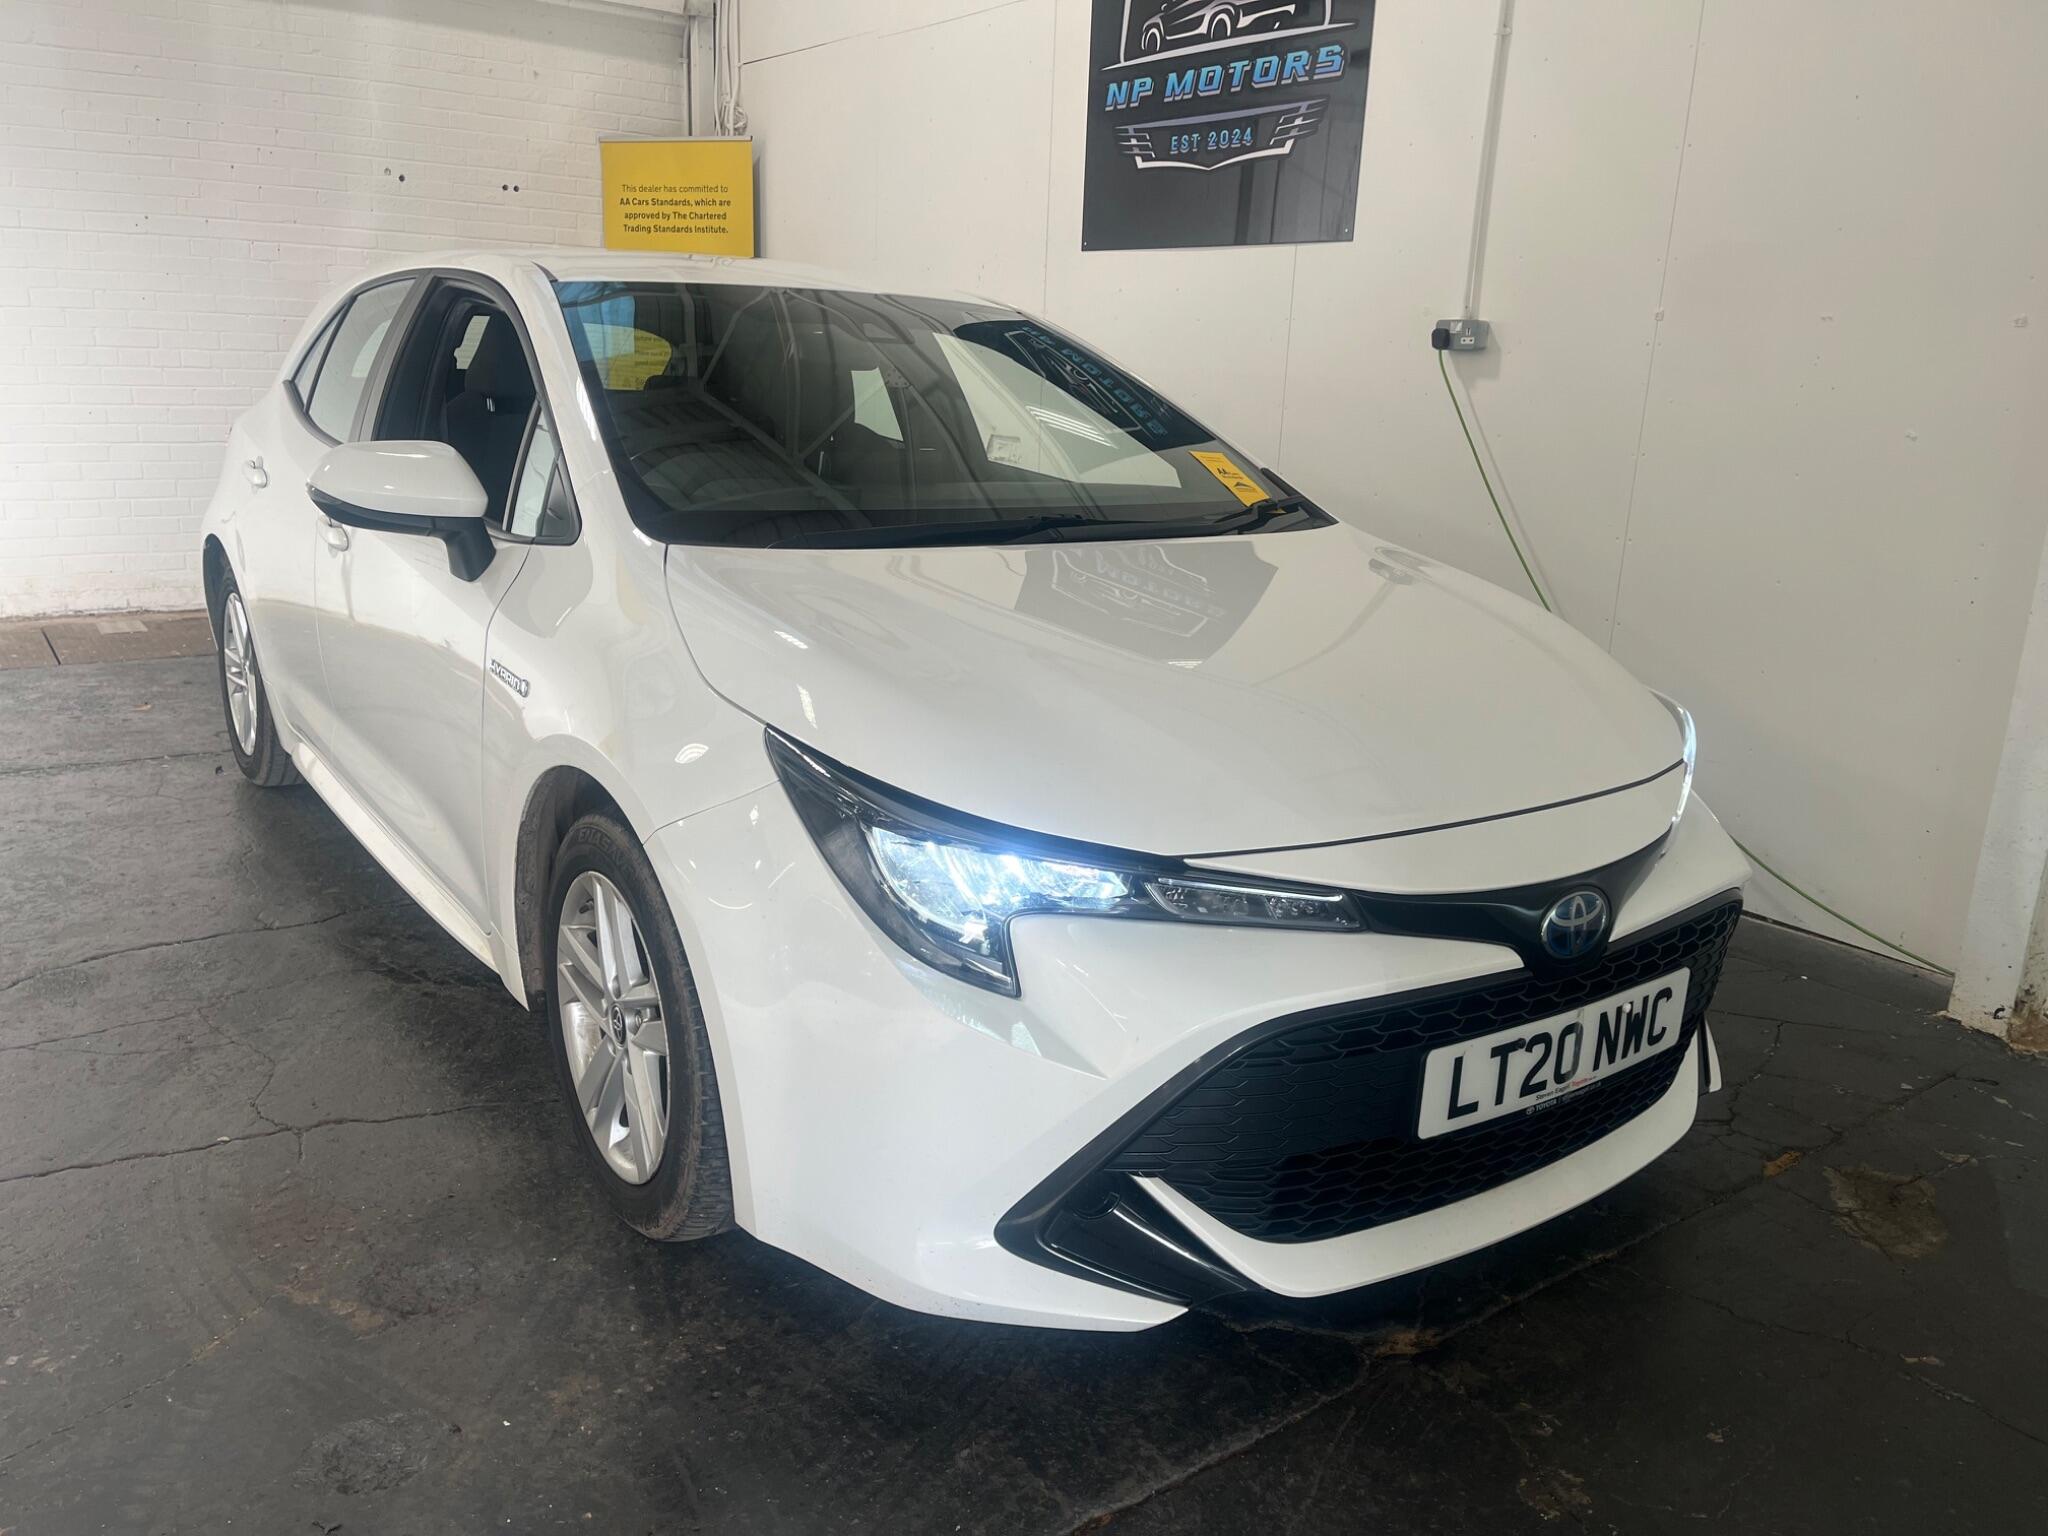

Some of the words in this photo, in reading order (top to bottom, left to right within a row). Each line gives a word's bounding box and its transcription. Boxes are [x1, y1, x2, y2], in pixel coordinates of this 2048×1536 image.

[1105, 77, 1154, 111] NP
[1163, 44, 1345, 102] MOTORS
[1169, 133, 1201, 154] EST
[1208, 127, 1253, 150] 2024
[622, 184, 637, 193] This
[638, 184, 662, 193] dealer
[663, 184, 677, 193] has
[679, 184, 718, 193] committed
[720, 184, 728, 193] to
[619, 198, 631, 206] AA
[631, 198, 649, 206] Cars
[651, 198, 693, 208] Standards,
[694, 198, 717, 206] which
[624, 212, 660, 221] approved
[661, 212, 671, 221] by
[672, 212, 687, 220] The
[688, 212, 727, 220] Chartered
[623, 224, 651, 234] Trading
[653, 224, 693, 233] Standards
[694, 224, 729, 234] Institute.
[1447, 1021, 1584, 1120] LT20
[1593, 986, 1673, 1072] NWC
